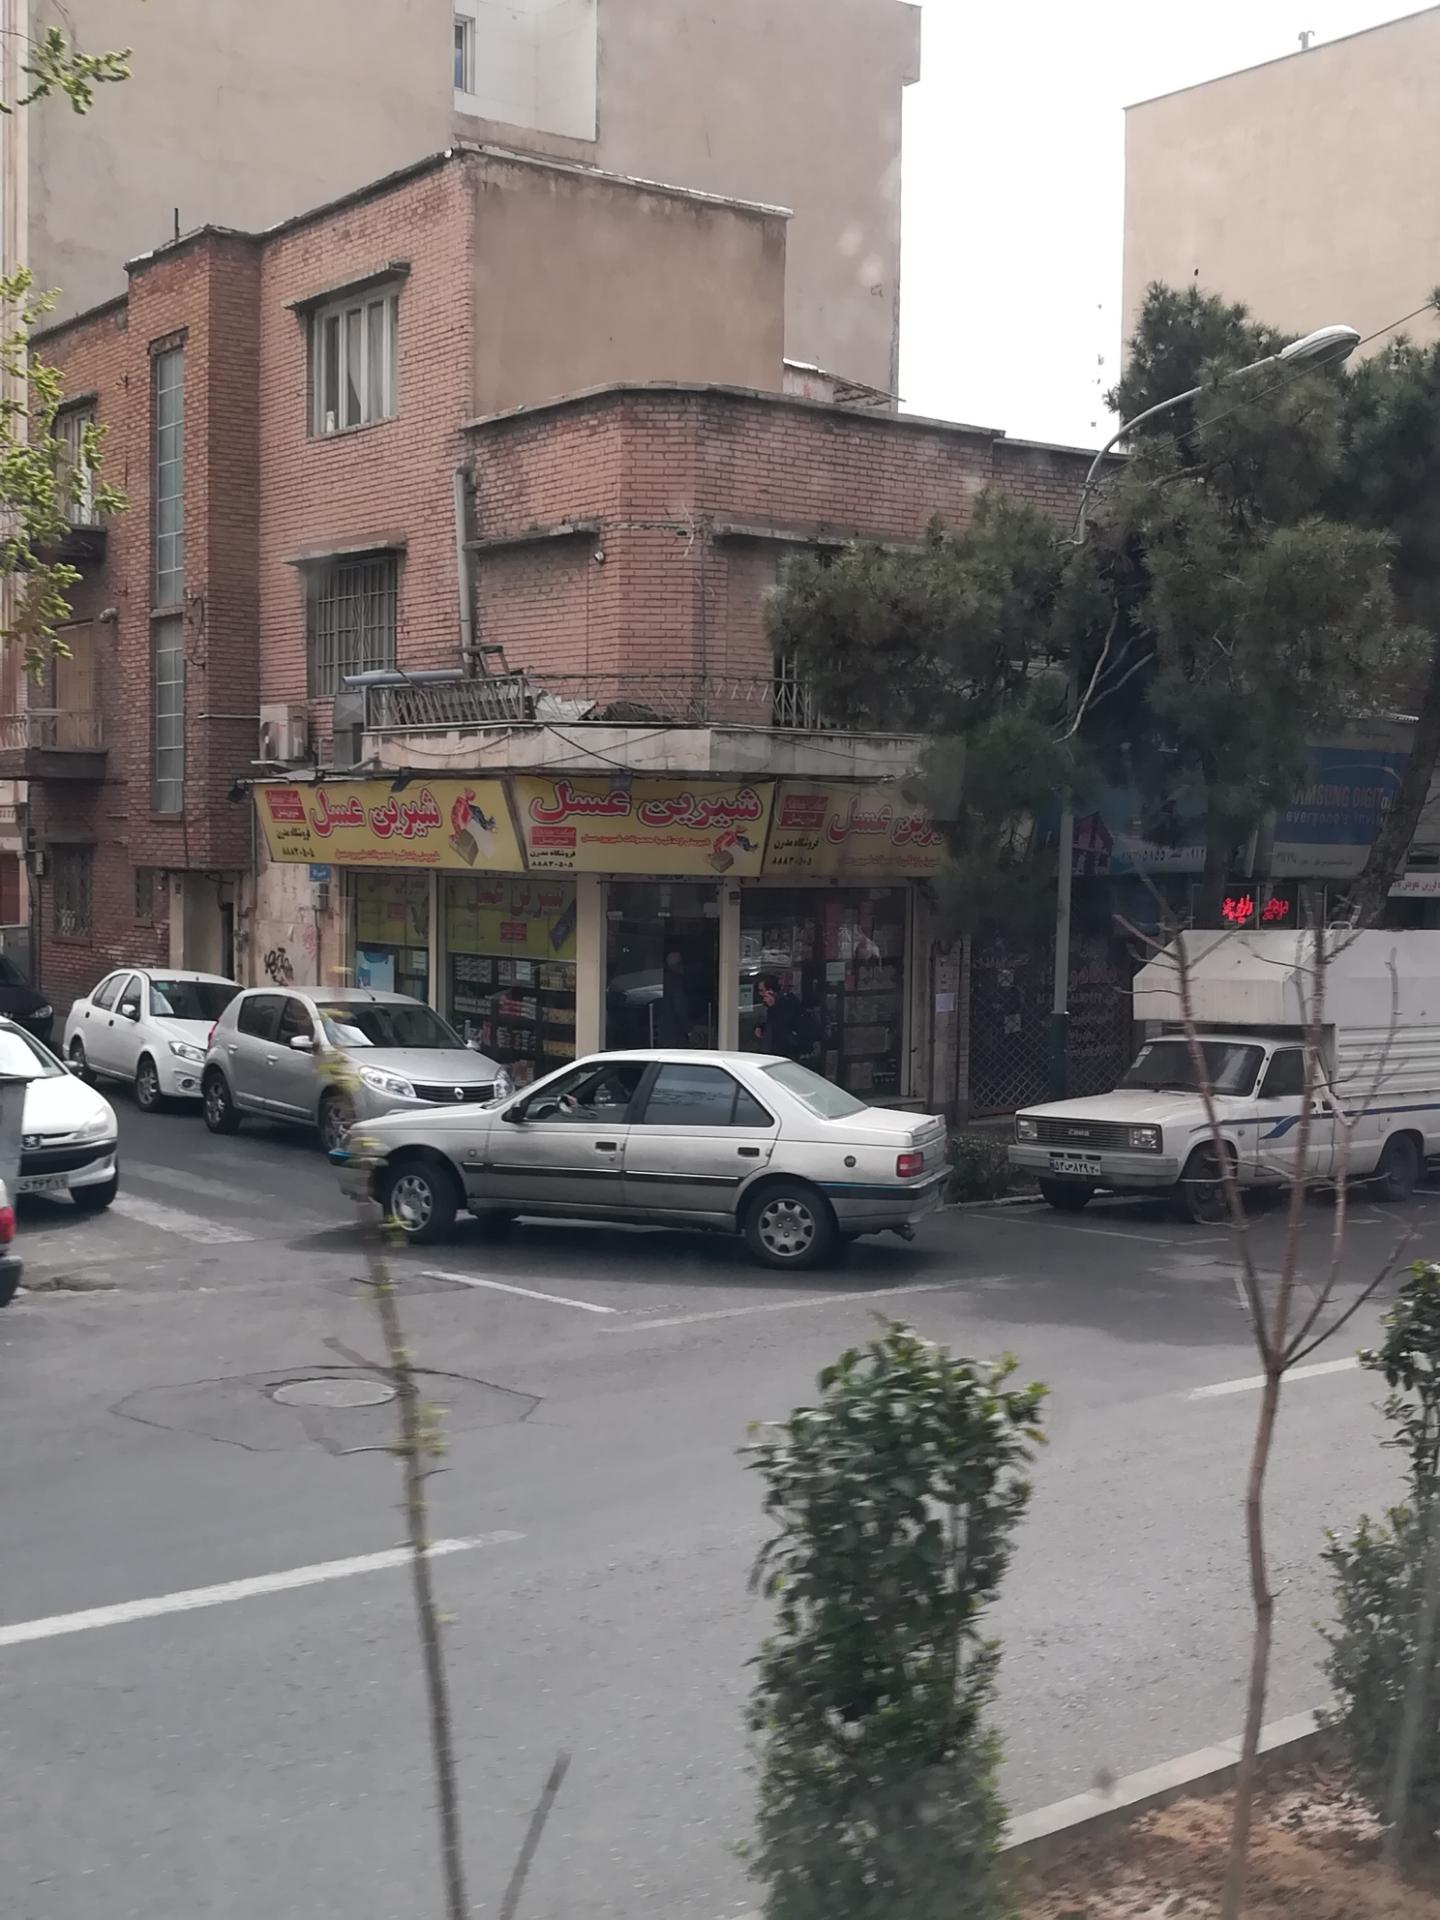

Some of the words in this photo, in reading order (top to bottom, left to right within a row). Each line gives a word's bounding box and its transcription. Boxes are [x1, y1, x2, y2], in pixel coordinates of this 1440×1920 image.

[310, 787, 367, 838] عسل
[369, 787, 441, 839] شیرین
[529, 779, 632, 824] عسل
[637, 786, 763, 828] شیرین
[826, 793, 893, 845] عسل
[550, 850, 576, 859] فروشگاه
